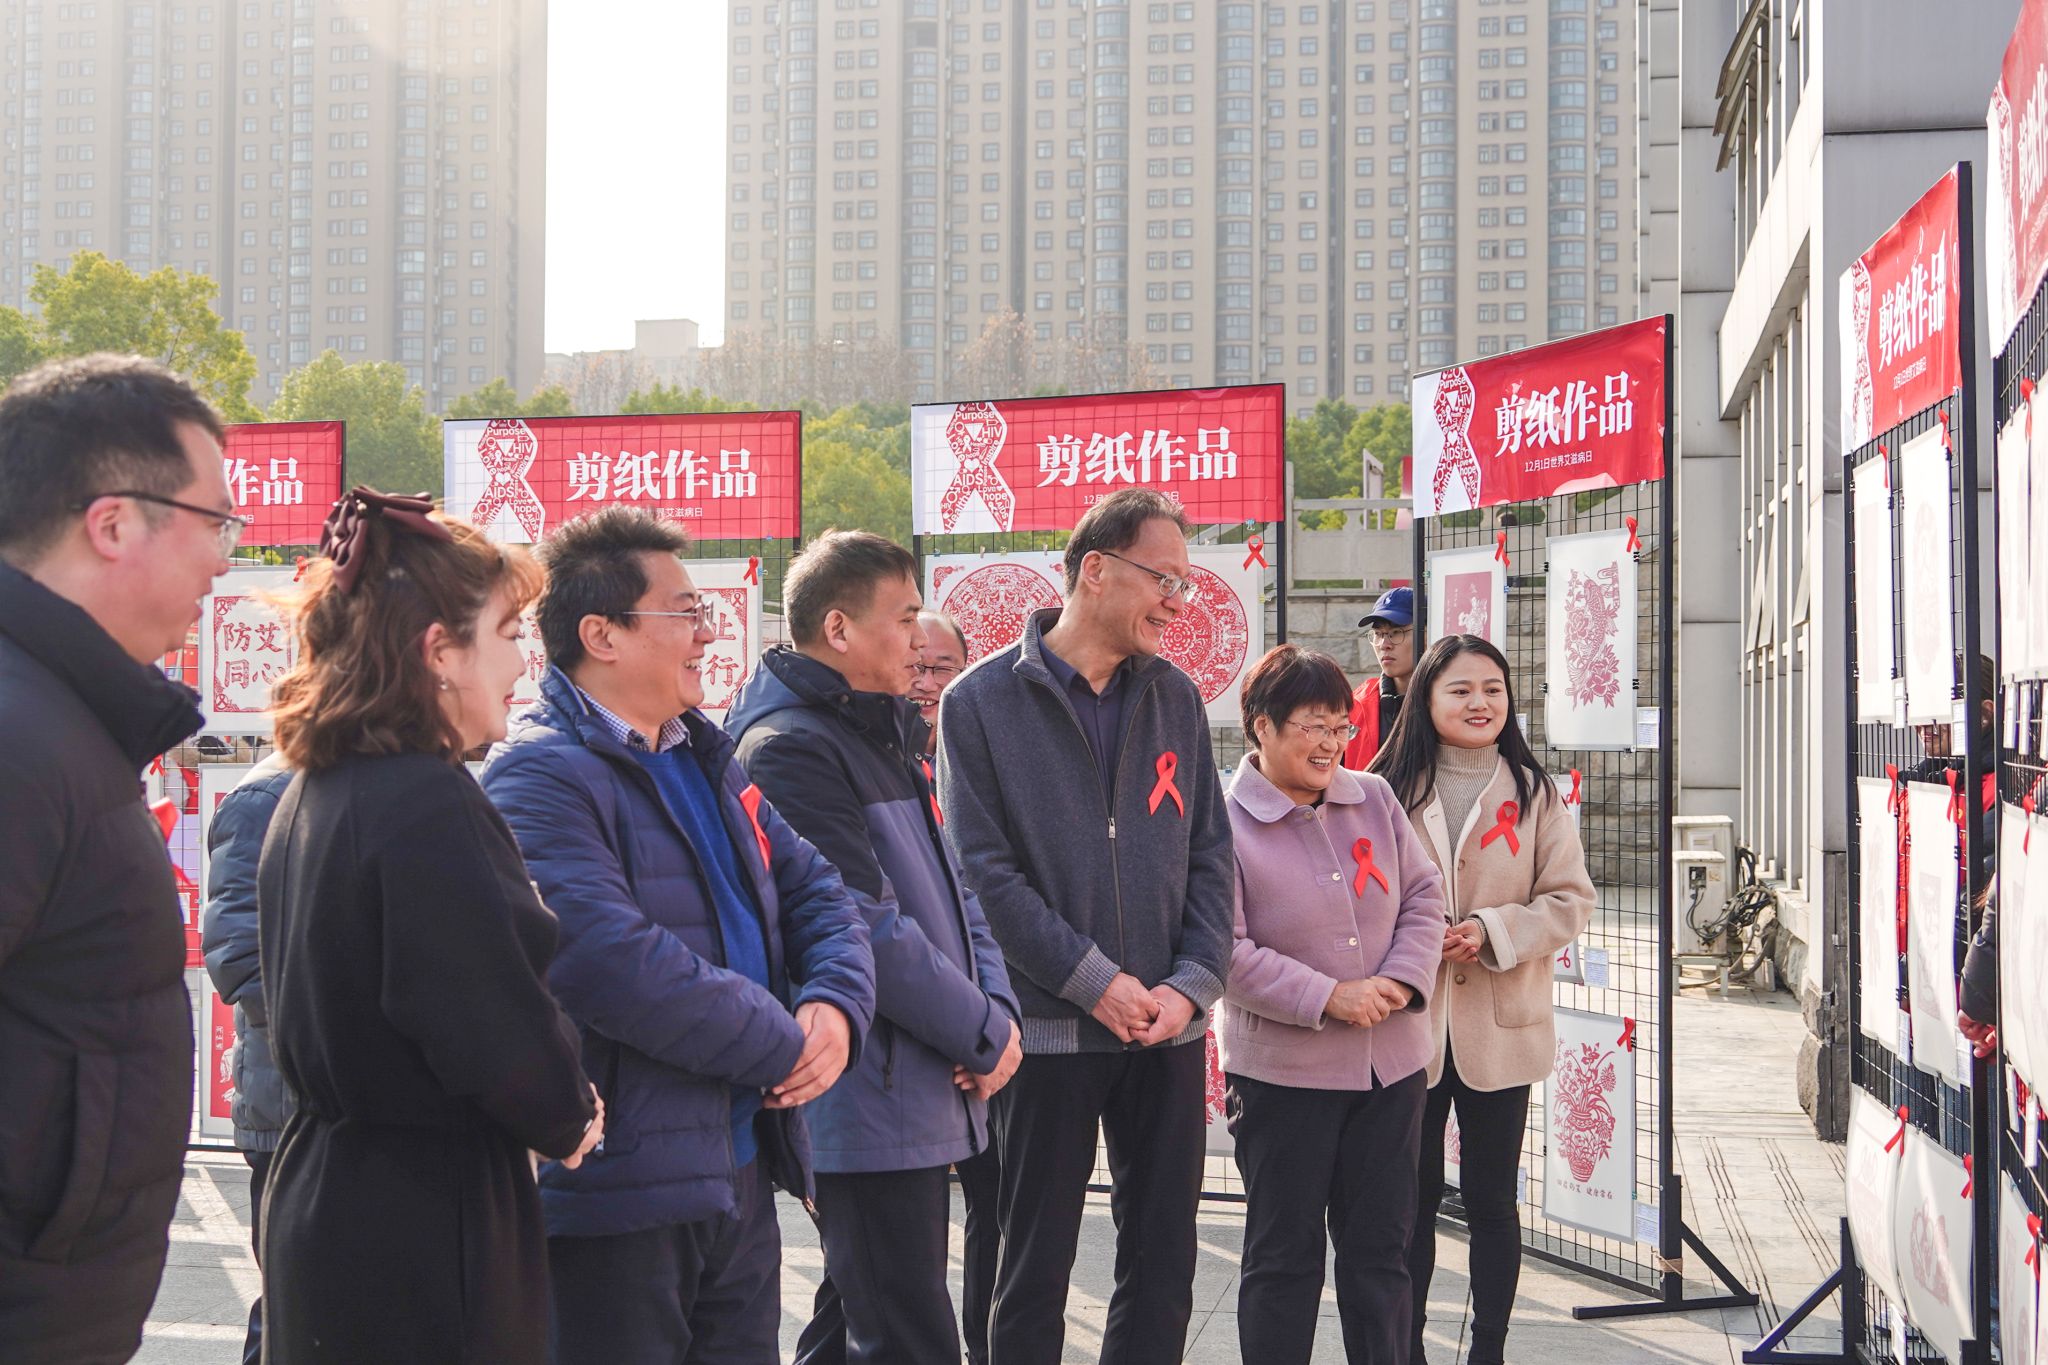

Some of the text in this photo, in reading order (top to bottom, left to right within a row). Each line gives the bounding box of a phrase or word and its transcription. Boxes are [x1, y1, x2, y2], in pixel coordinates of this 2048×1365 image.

[1879, 250, 1946, 372] 剪纸作品
[1458, 394, 1472, 407] HIV
[955, 411, 994, 421] Purpose
[1495, 371, 1633, 458] 剪纸作品
[486, 427, 526, 436] Purpose
[982, 427, 1002, 438] HIV
[513, 443, 533, 454] HIV
[947, 433, 965, 462] Love
[1036, 427, 1238, 488] 剪纸作品
[1441, 447, 1461, 461] AIDS
[478, 448, 497, 475] Love
[1460, 465, 1476, 476] hope
[1525, 450, 1592, 472] 12月1日世界艾滋病日
[224, 457, 304, 507] 作品
[566, 449, 757, 502] 剪纸作品
[953, 473, 983, 486] AIDS
[485, 487, 514, 498] AIDS
[983, 492, 1007, 502] hope
[514, 504, 538, 514] hope
[944, 494, 969, 530] Health
[223, 622, 283, 653] 防艾
[224, 659, 286, 688] 同心
[705, 654, 739, 687] 行
